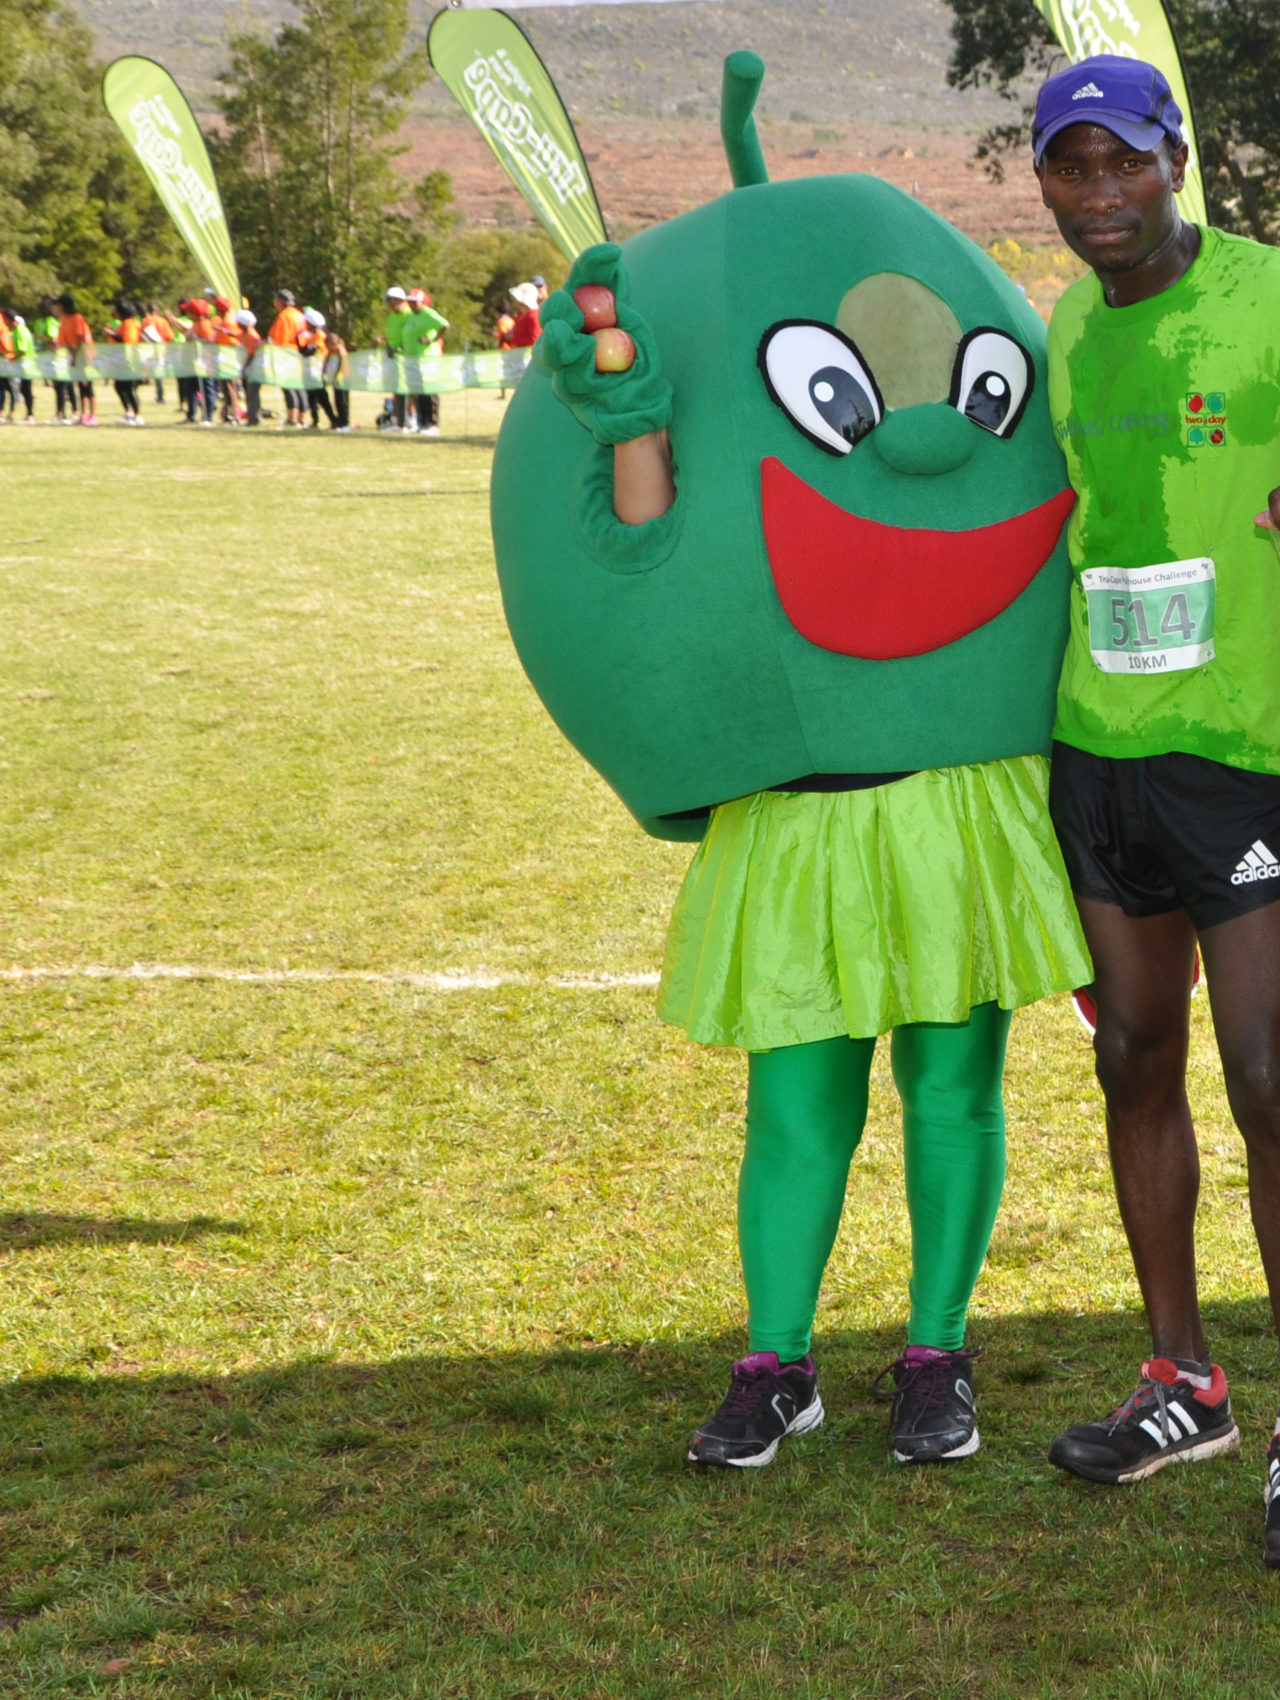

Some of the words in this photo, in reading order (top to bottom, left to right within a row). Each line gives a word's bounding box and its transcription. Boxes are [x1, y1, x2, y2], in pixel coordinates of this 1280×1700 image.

[1154, 568, 1198, 583] Challenge
[1110, 591, 1197, 648] 514
[1128, 654, 1167, 669] 10KM
